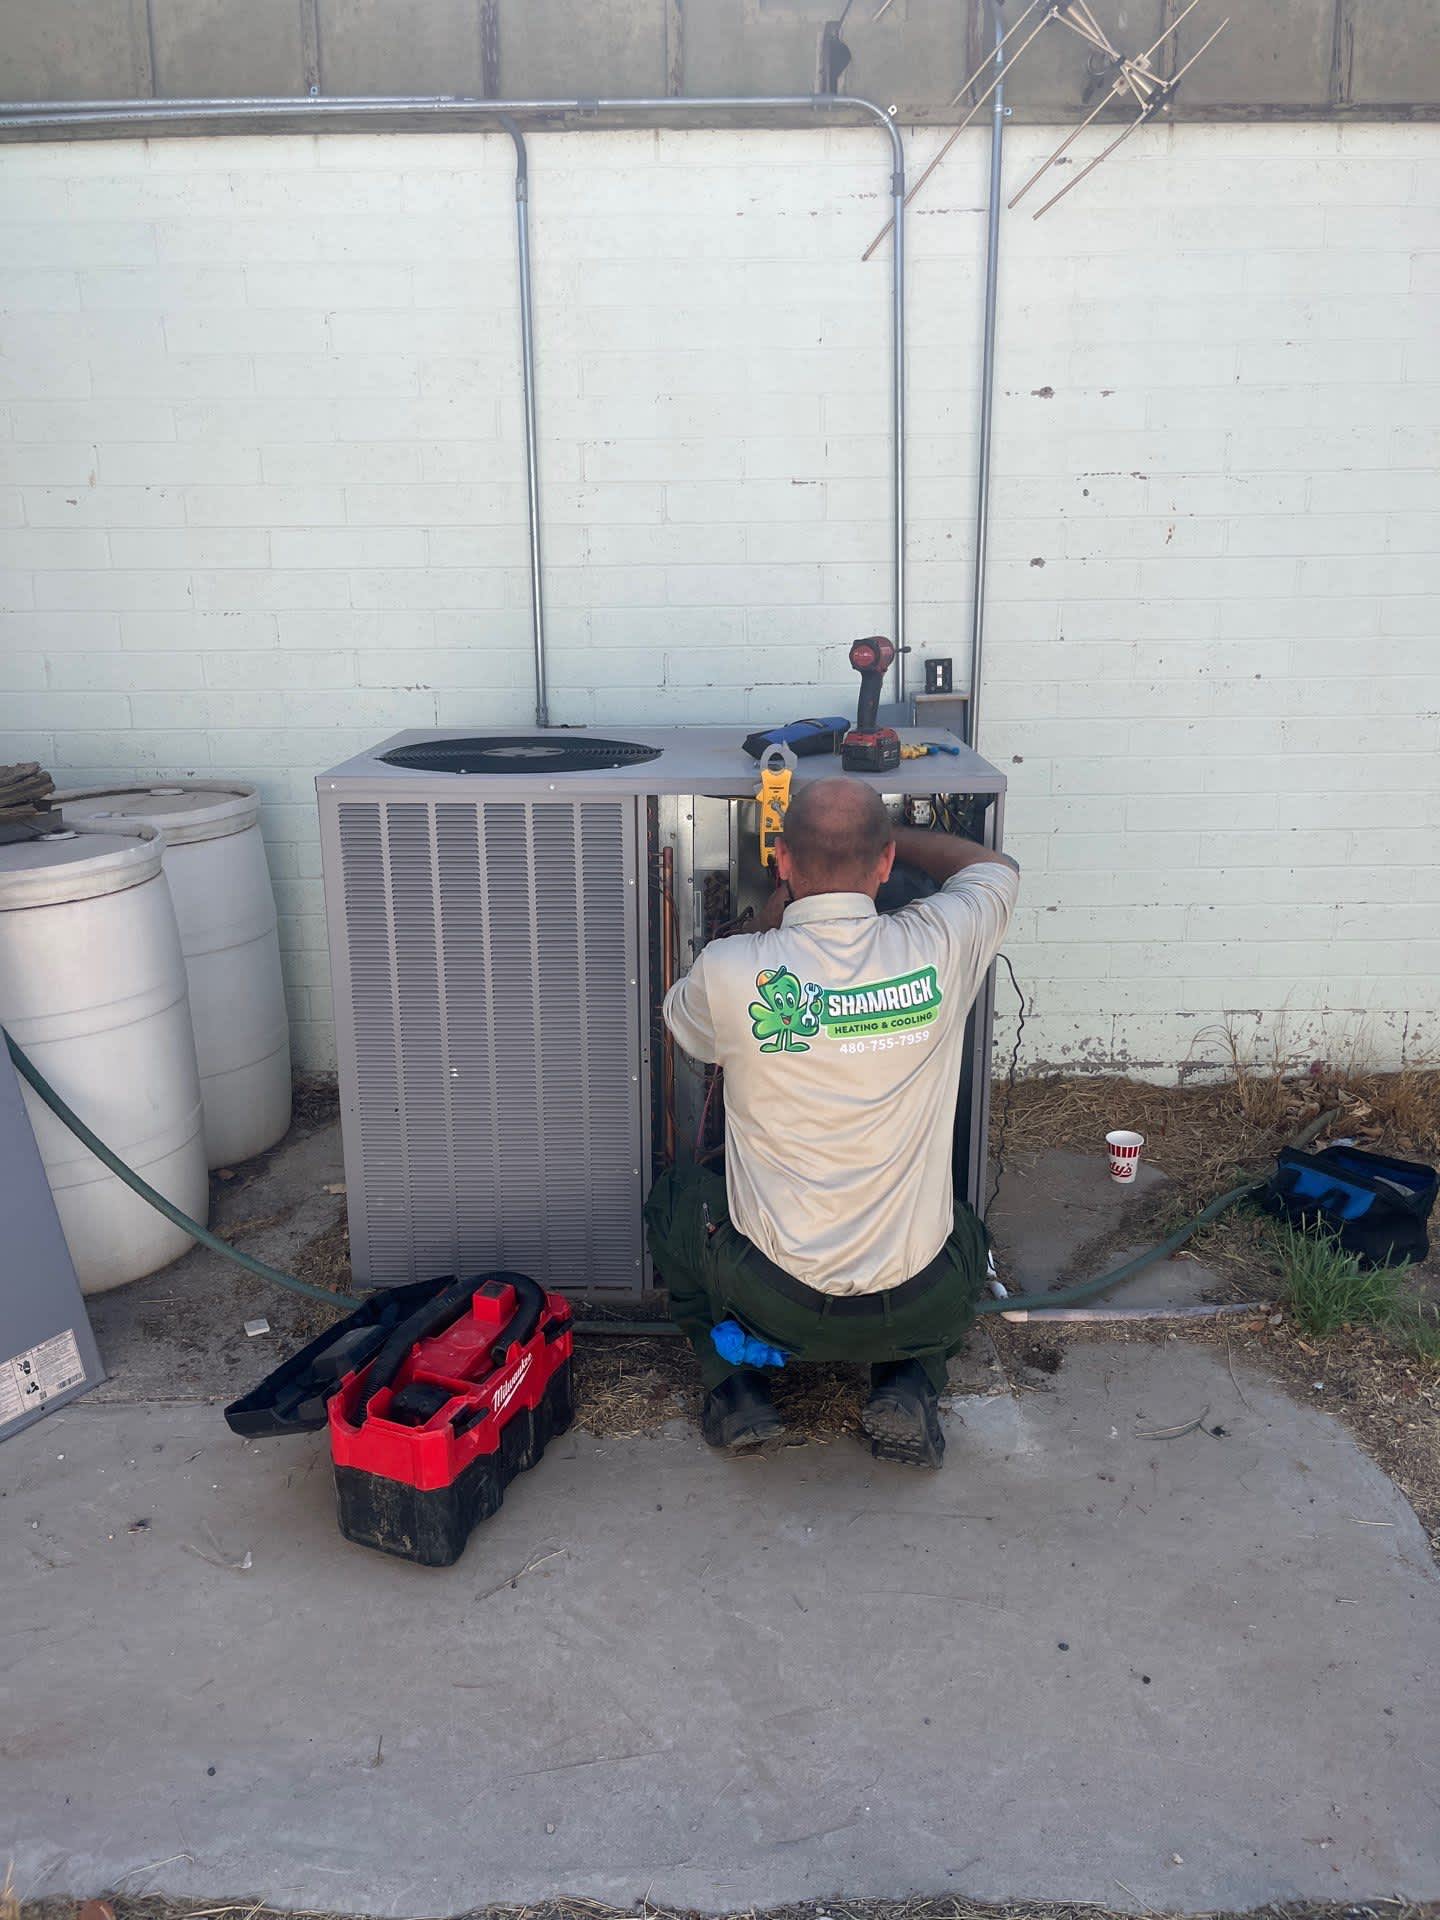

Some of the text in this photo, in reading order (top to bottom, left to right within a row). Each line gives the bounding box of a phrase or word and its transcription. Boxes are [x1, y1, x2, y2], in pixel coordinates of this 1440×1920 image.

[828, 975, 934, 1017] SHAMROCK
[835, 1011, 933, 1034] HEATING & COOLING
[840, 1030, 930, 1054] 480-755-7959
[491, 1352, 533, 1413] Milwaukee
